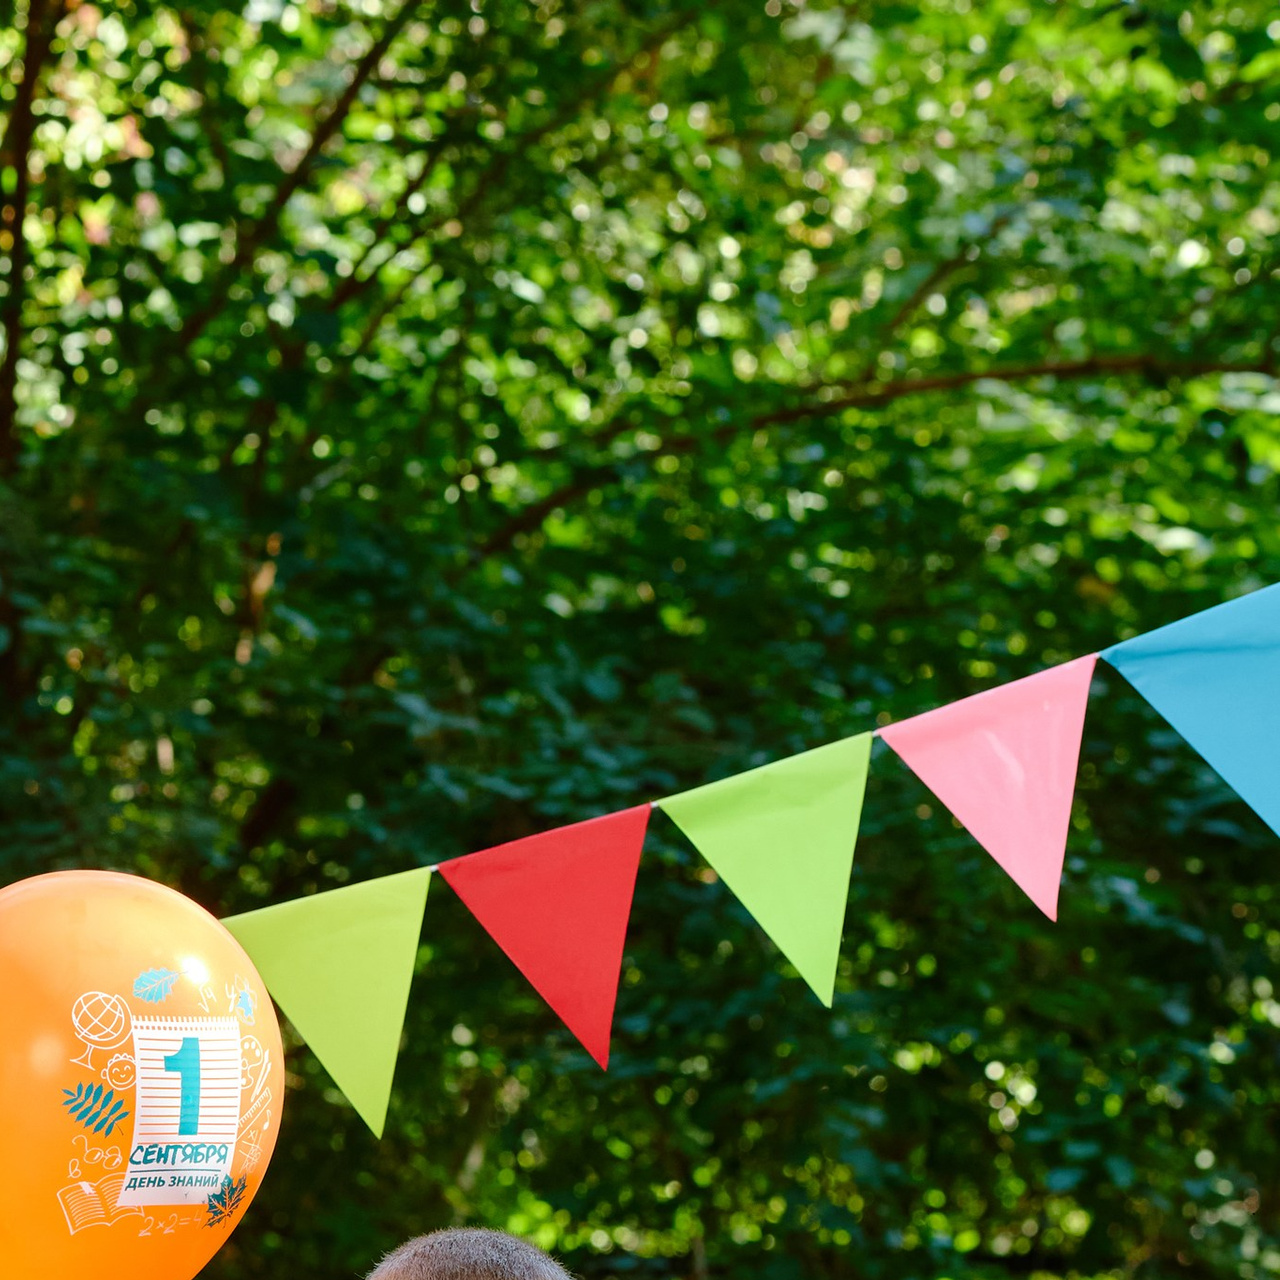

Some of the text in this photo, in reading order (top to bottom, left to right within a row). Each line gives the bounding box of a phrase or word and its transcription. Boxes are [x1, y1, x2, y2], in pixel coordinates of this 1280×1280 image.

[163, 1036, 201, 1136] 1
[128, 1143, 229, 1166] СЕНТЯБРЯ
[124, 1173, 220, 1191] ДЕНЬ ЗНАНИЙ
